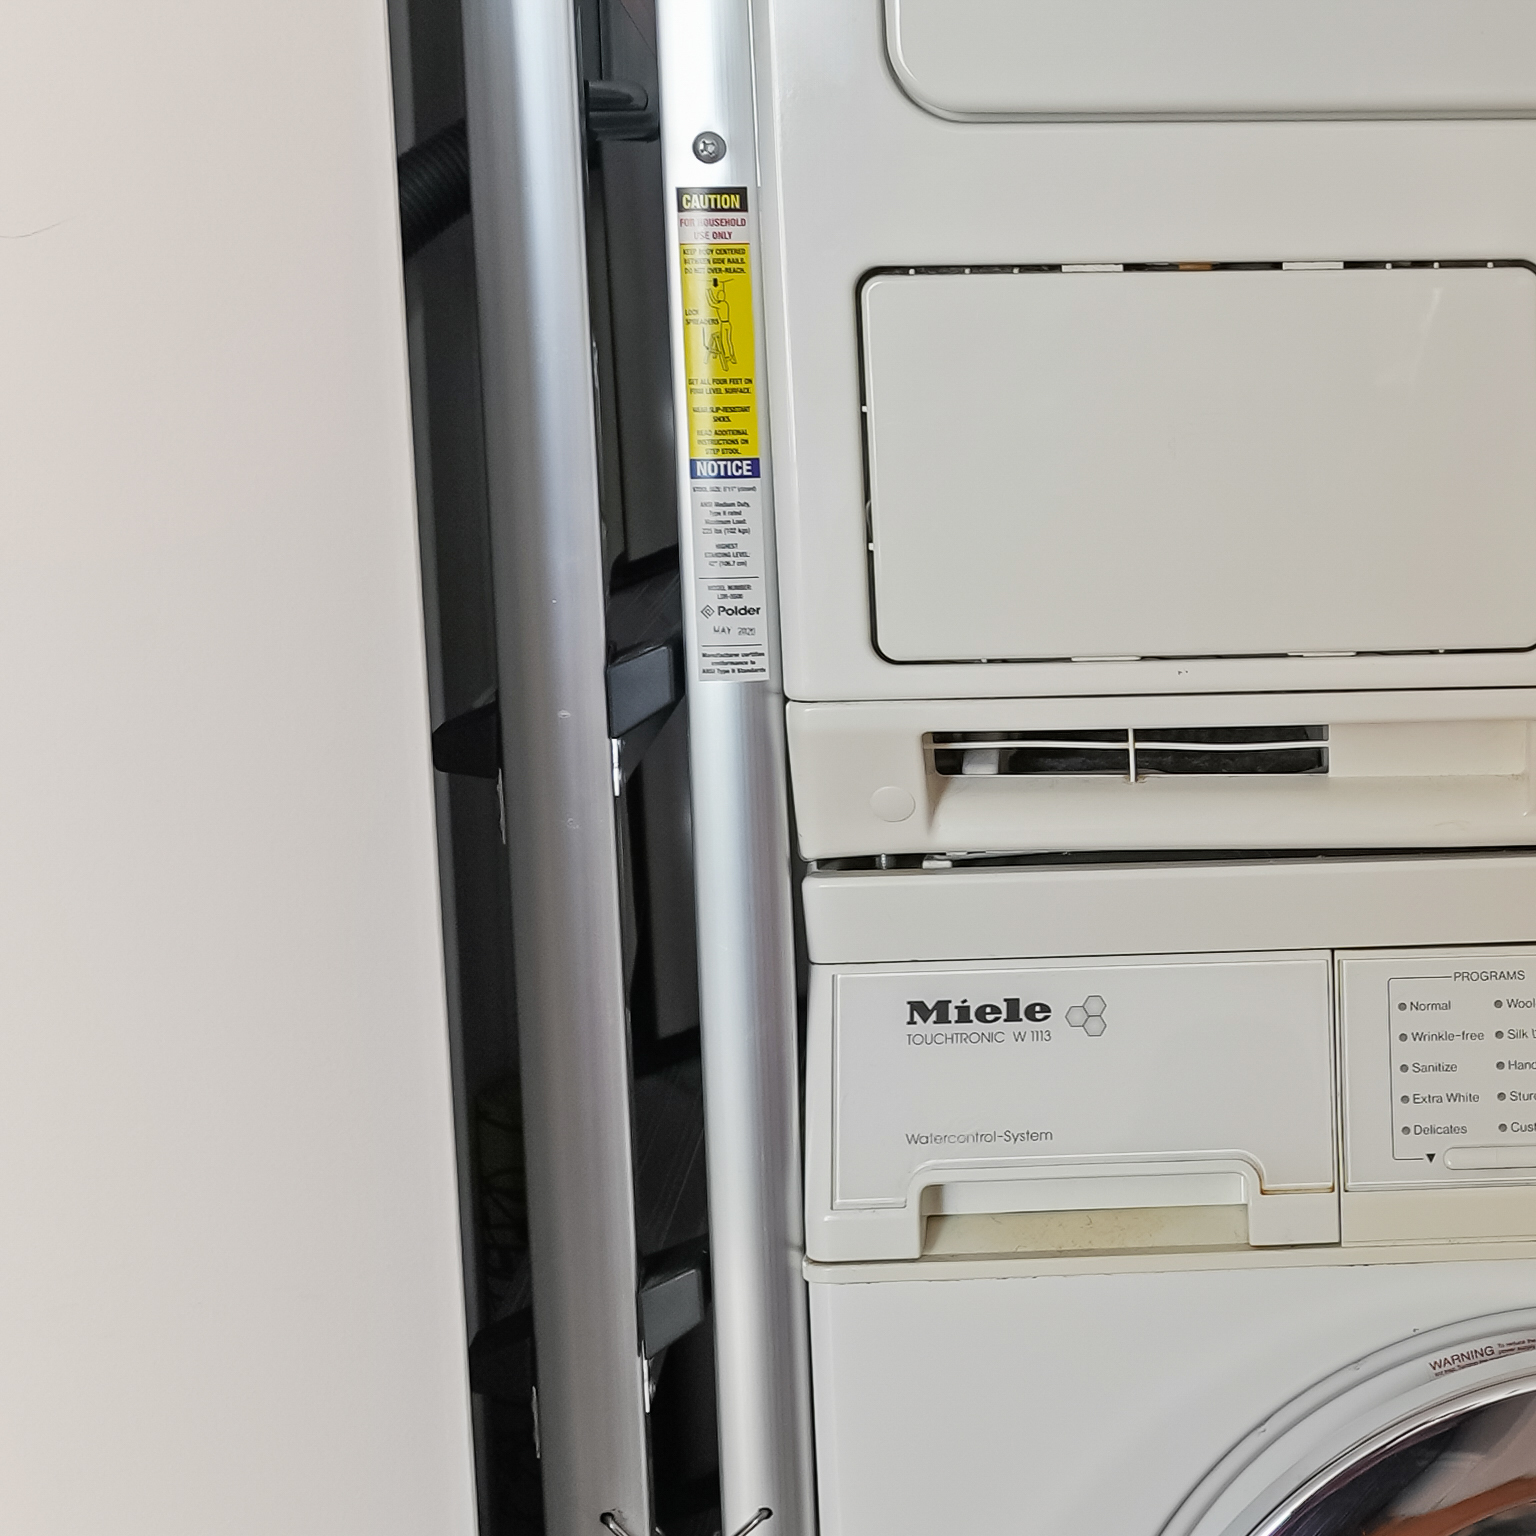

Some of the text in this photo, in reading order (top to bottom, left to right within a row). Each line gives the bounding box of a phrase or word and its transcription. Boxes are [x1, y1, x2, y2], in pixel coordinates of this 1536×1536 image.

[681, 193, 741, 210] CAUTION
[712, 231, 733, 240] ONLY
[696, 460, 753, 477] NOTICE
[717, 605, 761, 617] Polder
[1453, 969, 1526, 982] PROGRAMS
[906, 997, 1052, 1026] Miele
[1409, 999, 1452, 1012] Normal
[906, 1029, 1052, 1046] TOUCHTRONIC W 1113
[1410, 1030, 1485, 1042] Wrinkle-free
[1507, 1028, 1529, 1040] Silk
[1411, 1062, 1458, 1074] Sanitize
[1412, 1092, 1480, 1105] Extra White
[1413, 1124, 1468, 1136] Delicates
[905, 1129, 1054, 1145] Watercontrol-System
[1429, 1345, 1495, 1371] WARNING
